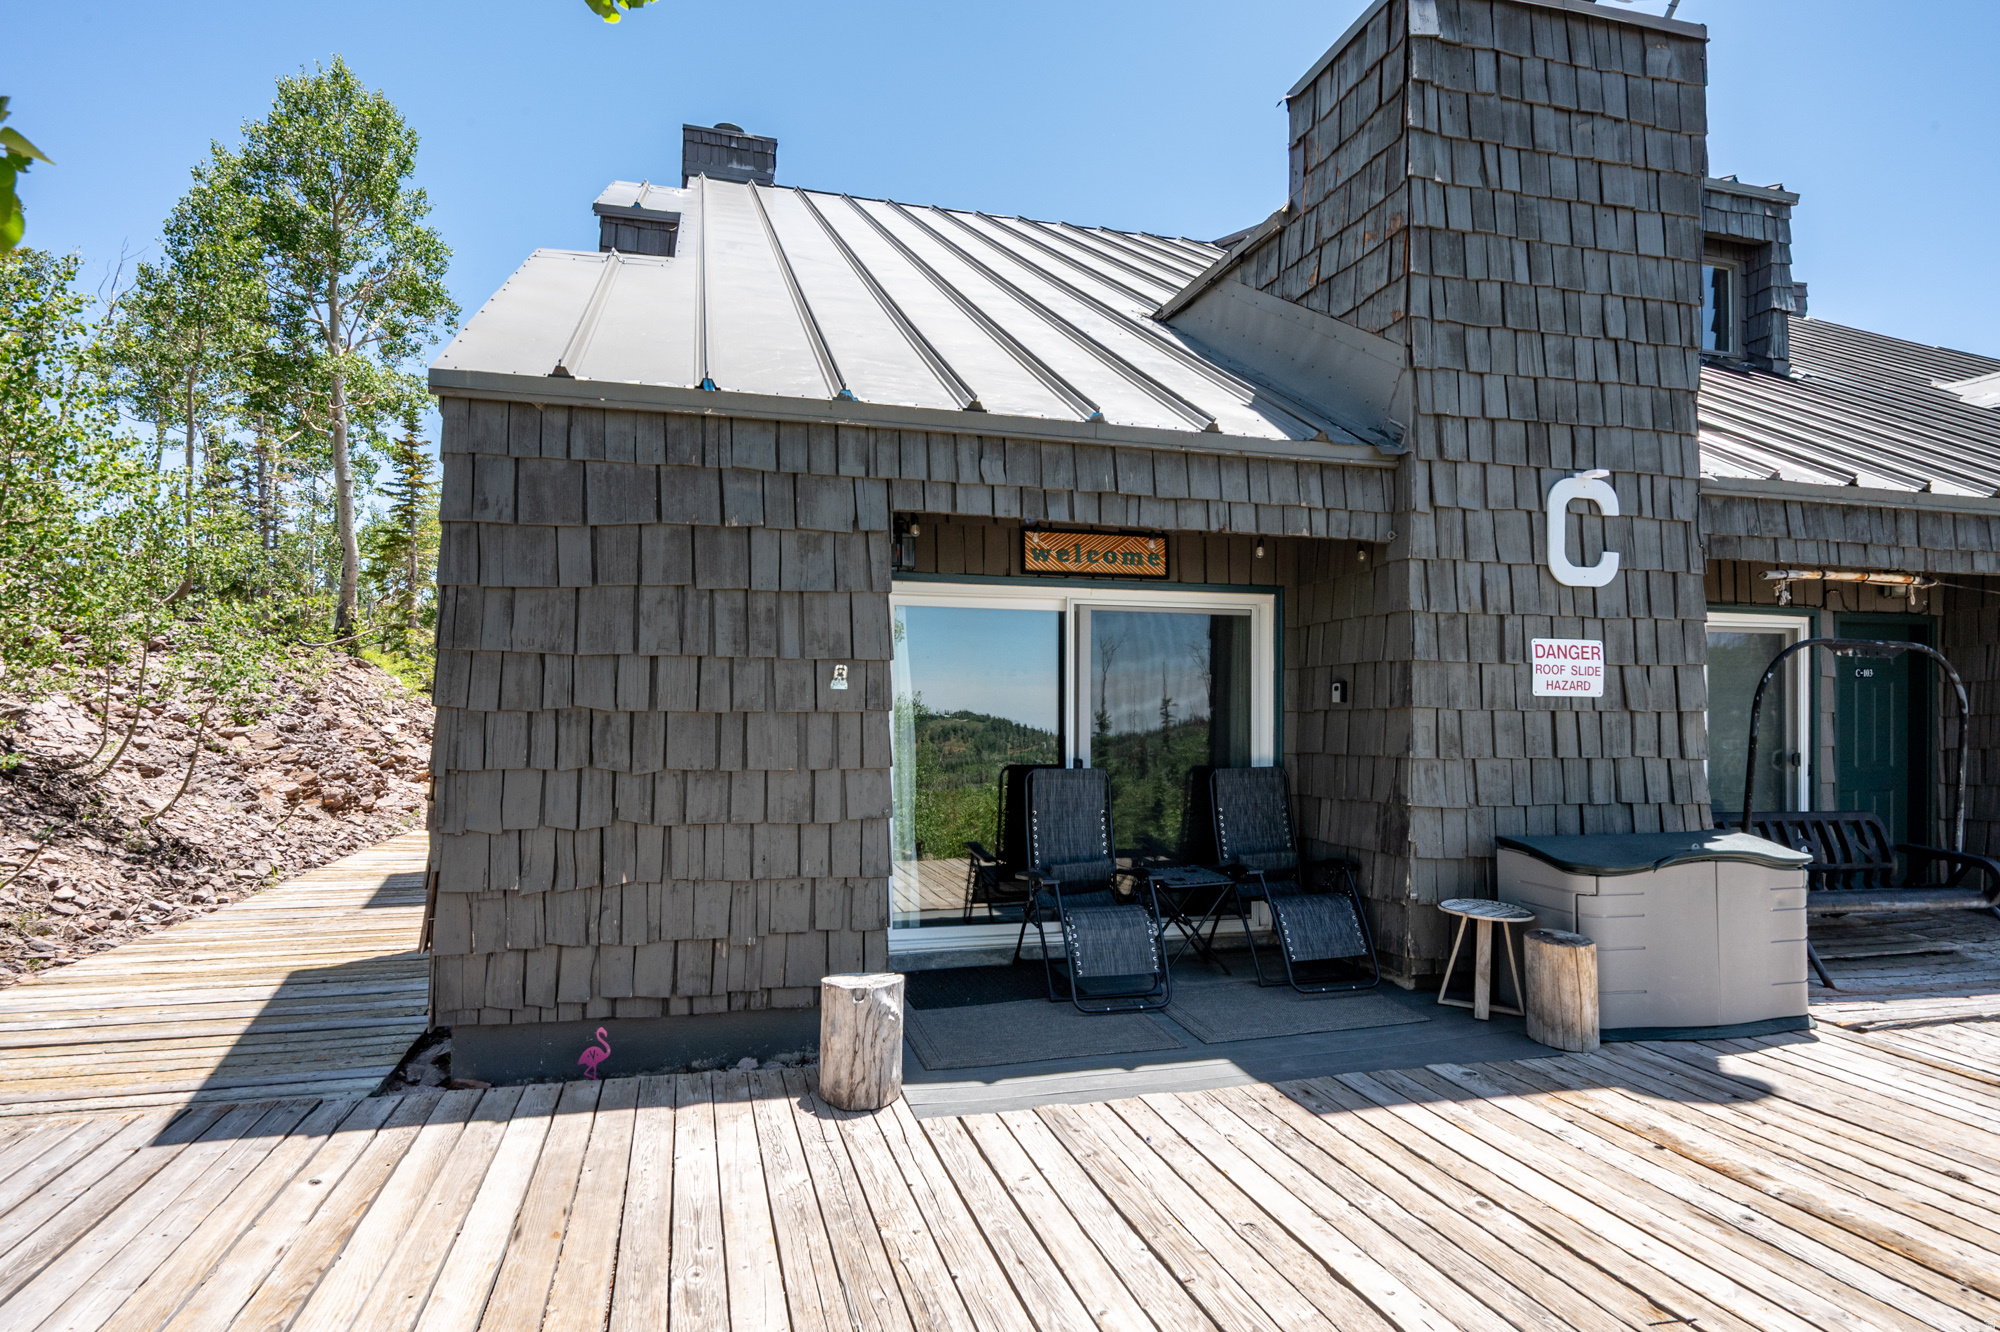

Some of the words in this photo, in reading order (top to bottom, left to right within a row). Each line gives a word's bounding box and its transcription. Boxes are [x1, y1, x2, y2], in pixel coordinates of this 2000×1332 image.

[1547, 477, 1620, 588] C
[1030, 543, 1161, 567] welcome
[1534, 643, 1601, 661] DANGER
[1535, 663, 1566, 675] ROOF
[1571, 665, 1601, 677] SLIDE
[1546, 680, 1591, 691] HAZARD
